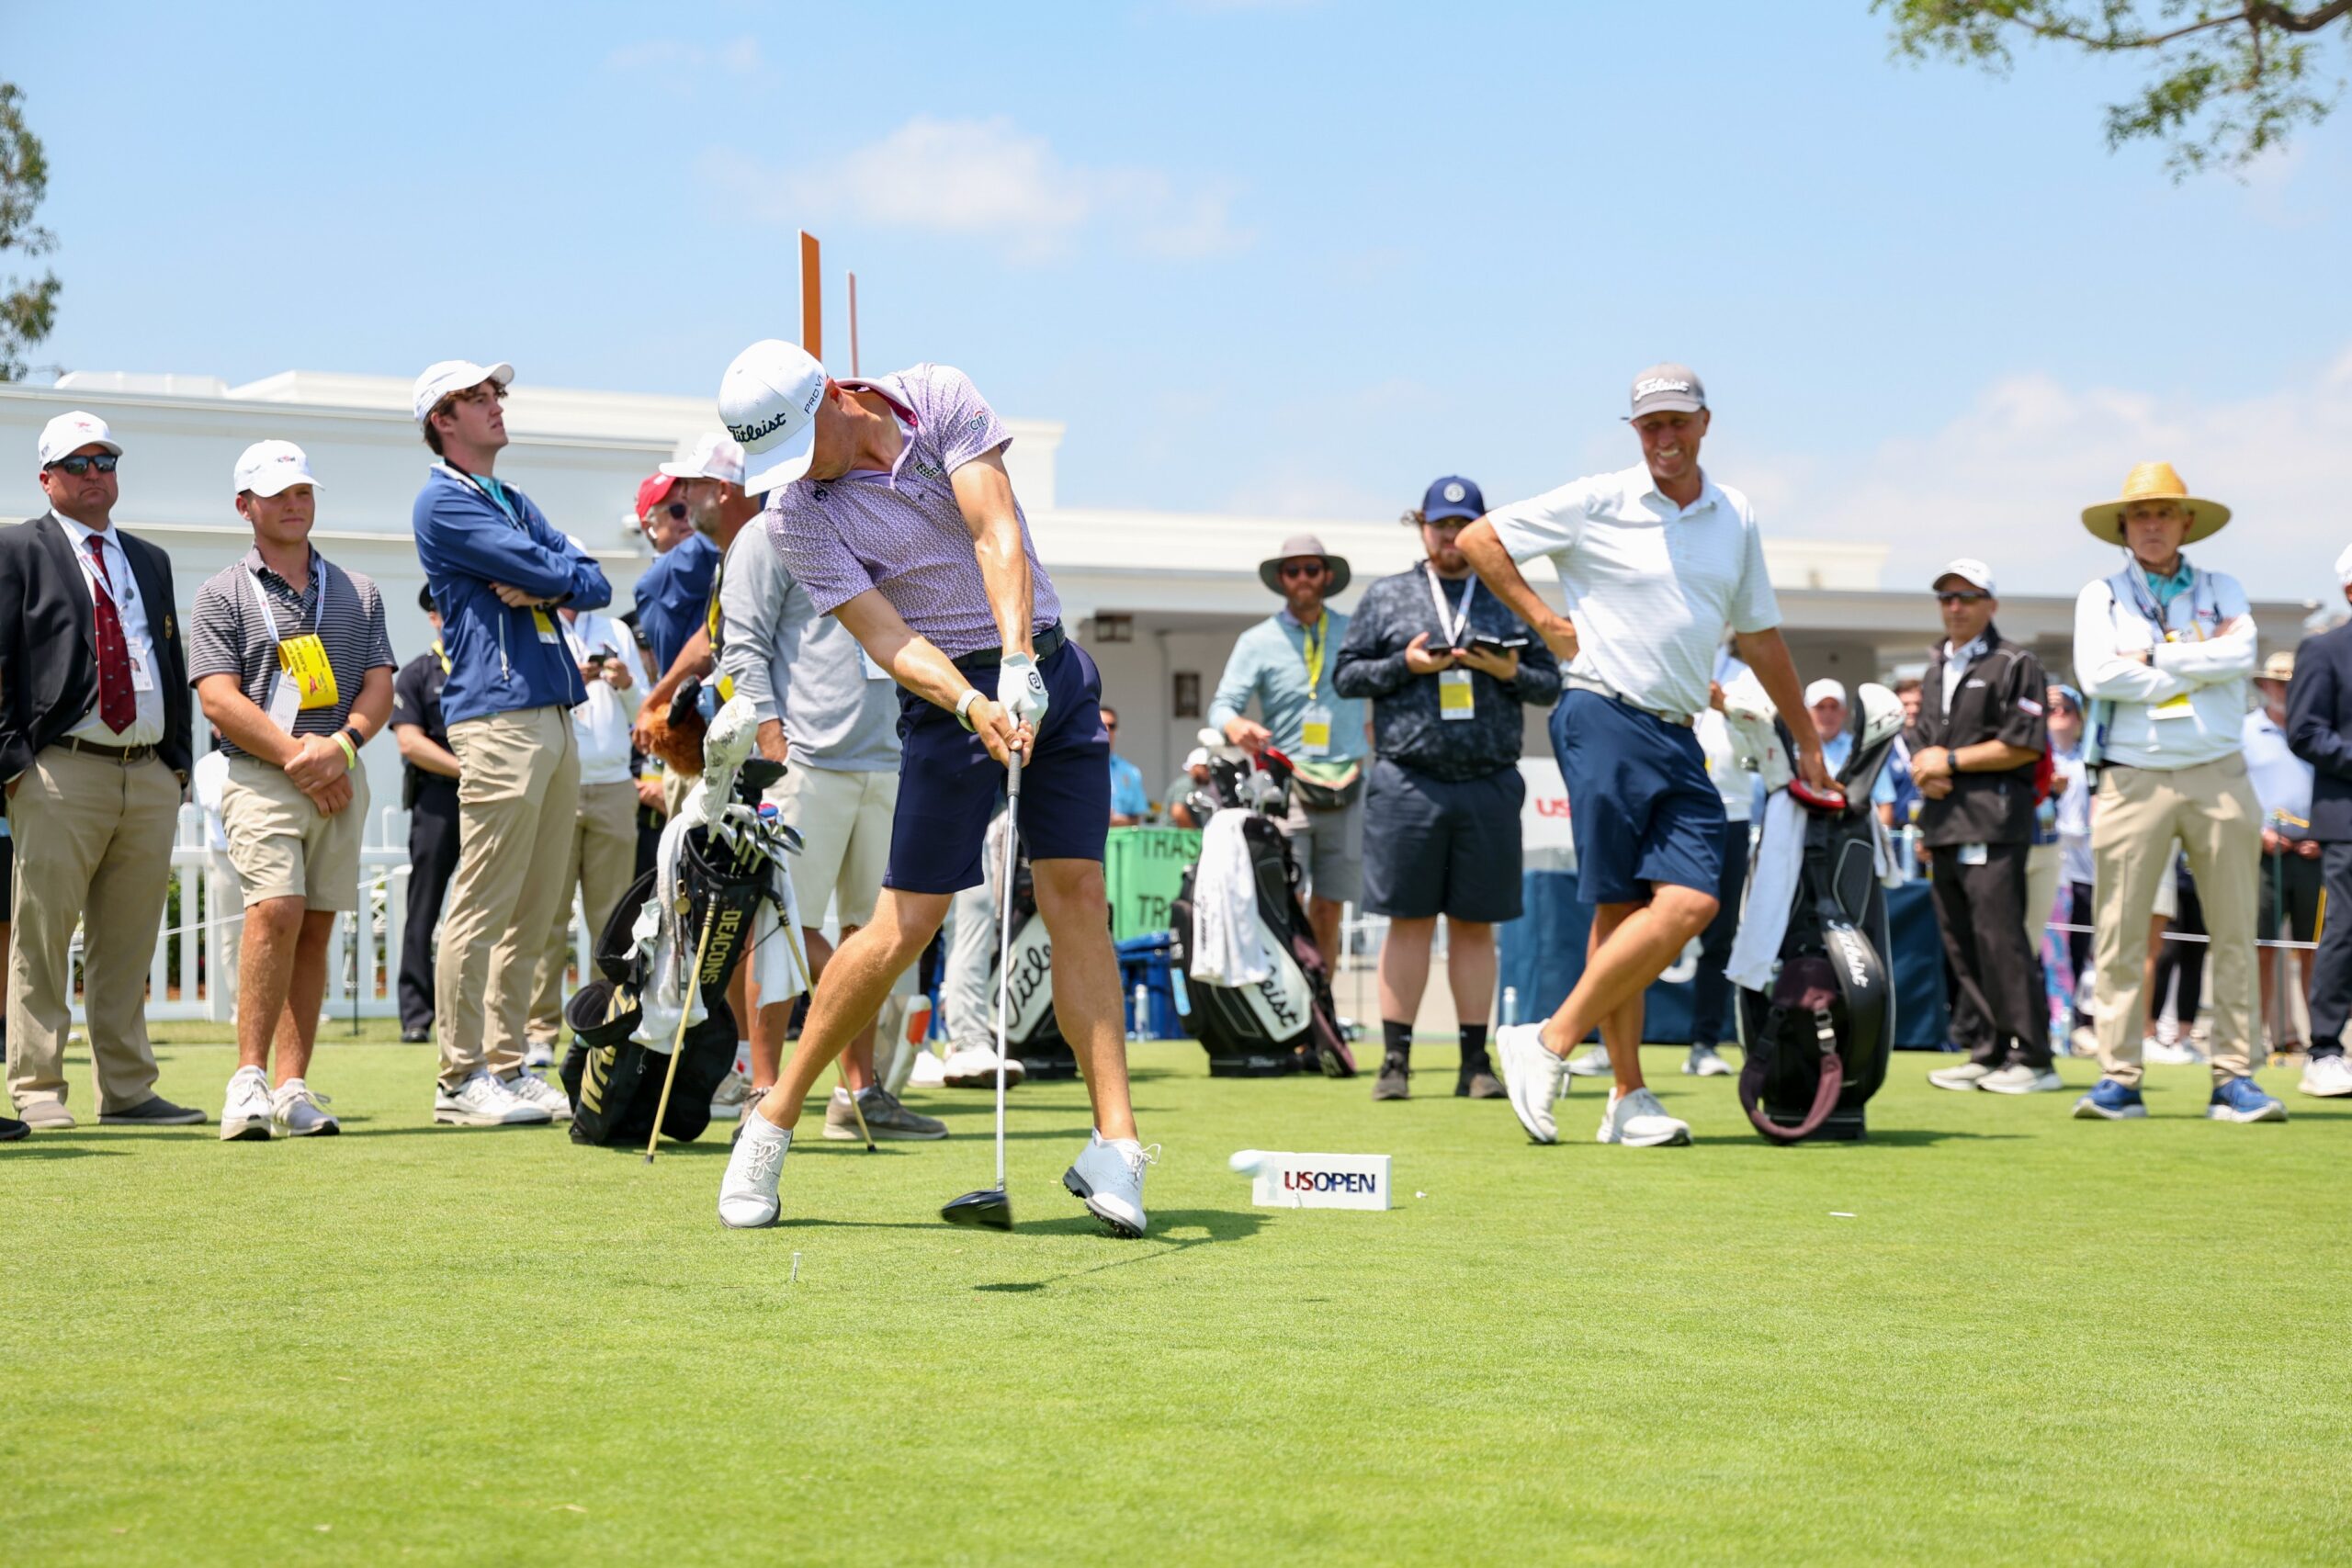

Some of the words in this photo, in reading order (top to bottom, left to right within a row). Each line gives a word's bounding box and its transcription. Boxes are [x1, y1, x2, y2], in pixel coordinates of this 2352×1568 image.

[804, 389, 820, 414] PRO
[816, 375, 824, 387] V1
[727, 412, 786, 443] Titleist
[1536, 796, 1570, 818] US
[1141, 830, 1201, 859] TRAS
[1137, 895, 1170, 929] TR
[701, 910, 742, 984] DEACONS
[993, 944, 1051, 1028] Title
[1257, 963, 1298, 1028] eist
